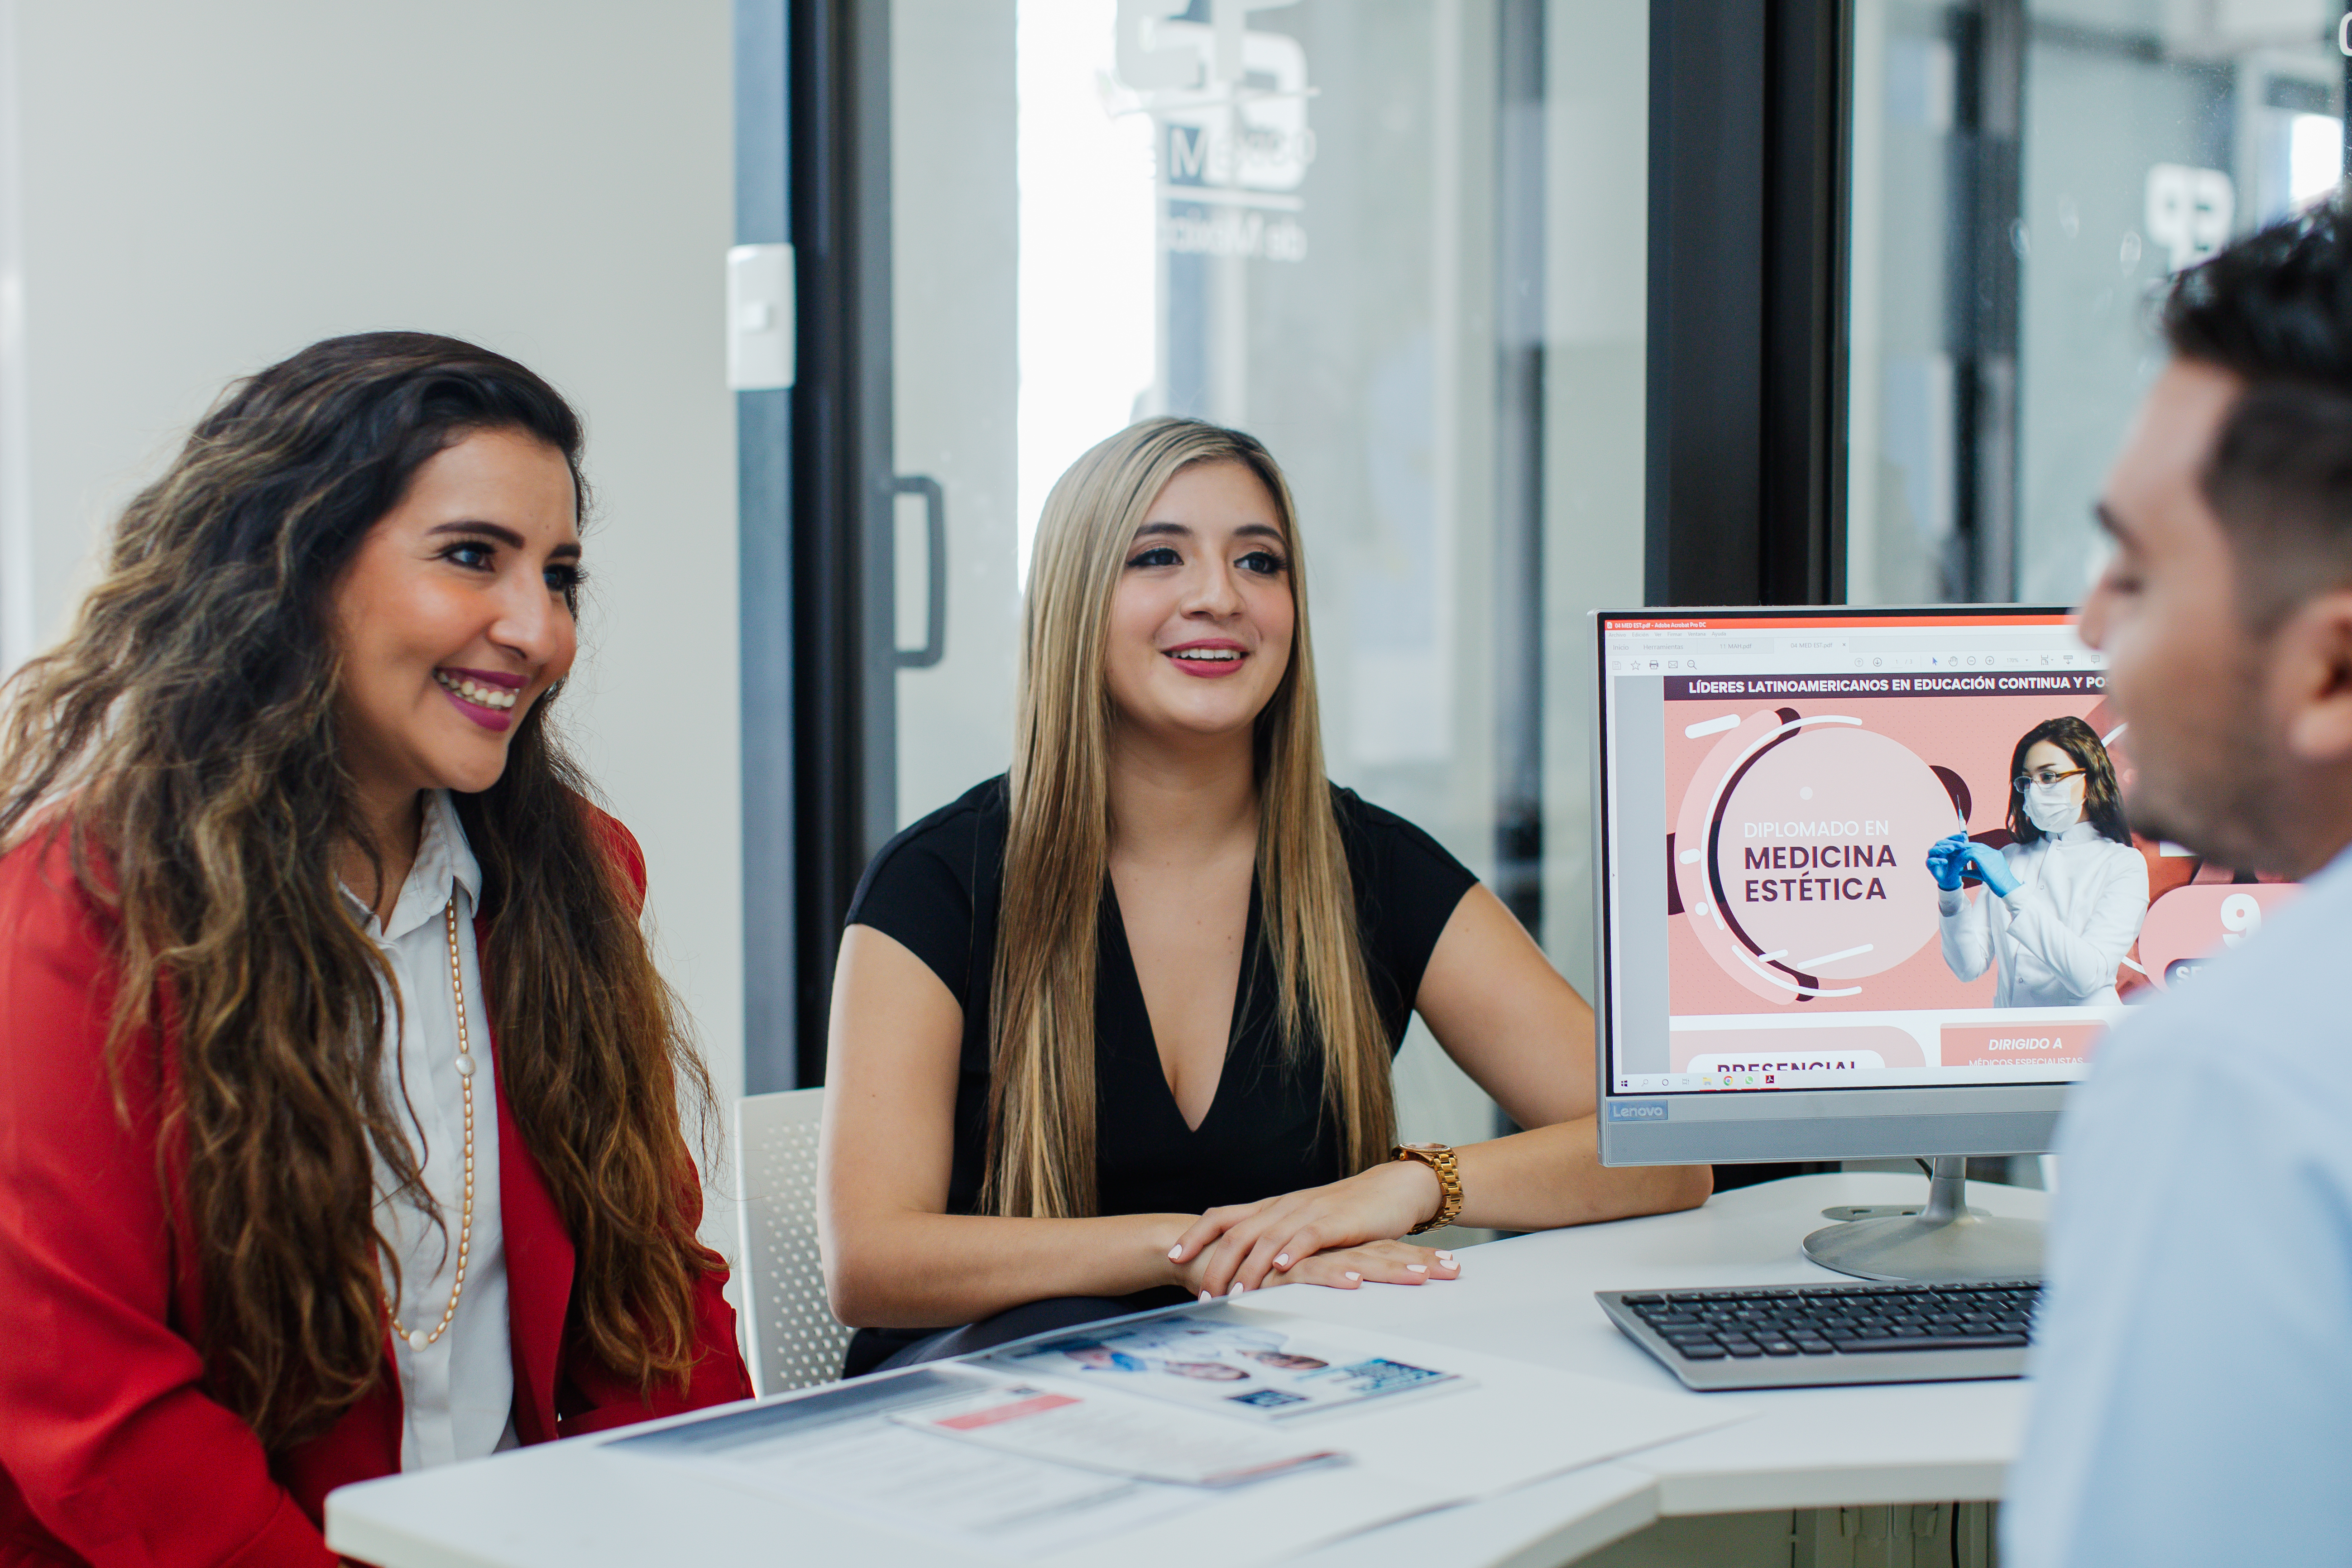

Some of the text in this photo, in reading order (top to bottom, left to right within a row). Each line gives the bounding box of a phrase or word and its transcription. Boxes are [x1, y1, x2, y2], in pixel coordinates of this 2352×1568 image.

[1689, 676, 2108, 694] LÍDERES LATINOAMERICANOS EN EDUCACIÓN CONTINUA Y PO
[1744, 820, 1888, 838] DIPLOMADO EN
[1744, 844, 1897, 869] MEDICINA
[1745, 870, 1887, 902] ESTÉTICA
[2220, 893, 2262, 950] 9
[1988, 1037, 2063, 1050] DIRIGIDO A
[1613, 1105, 1663, 1117] Lenovo
